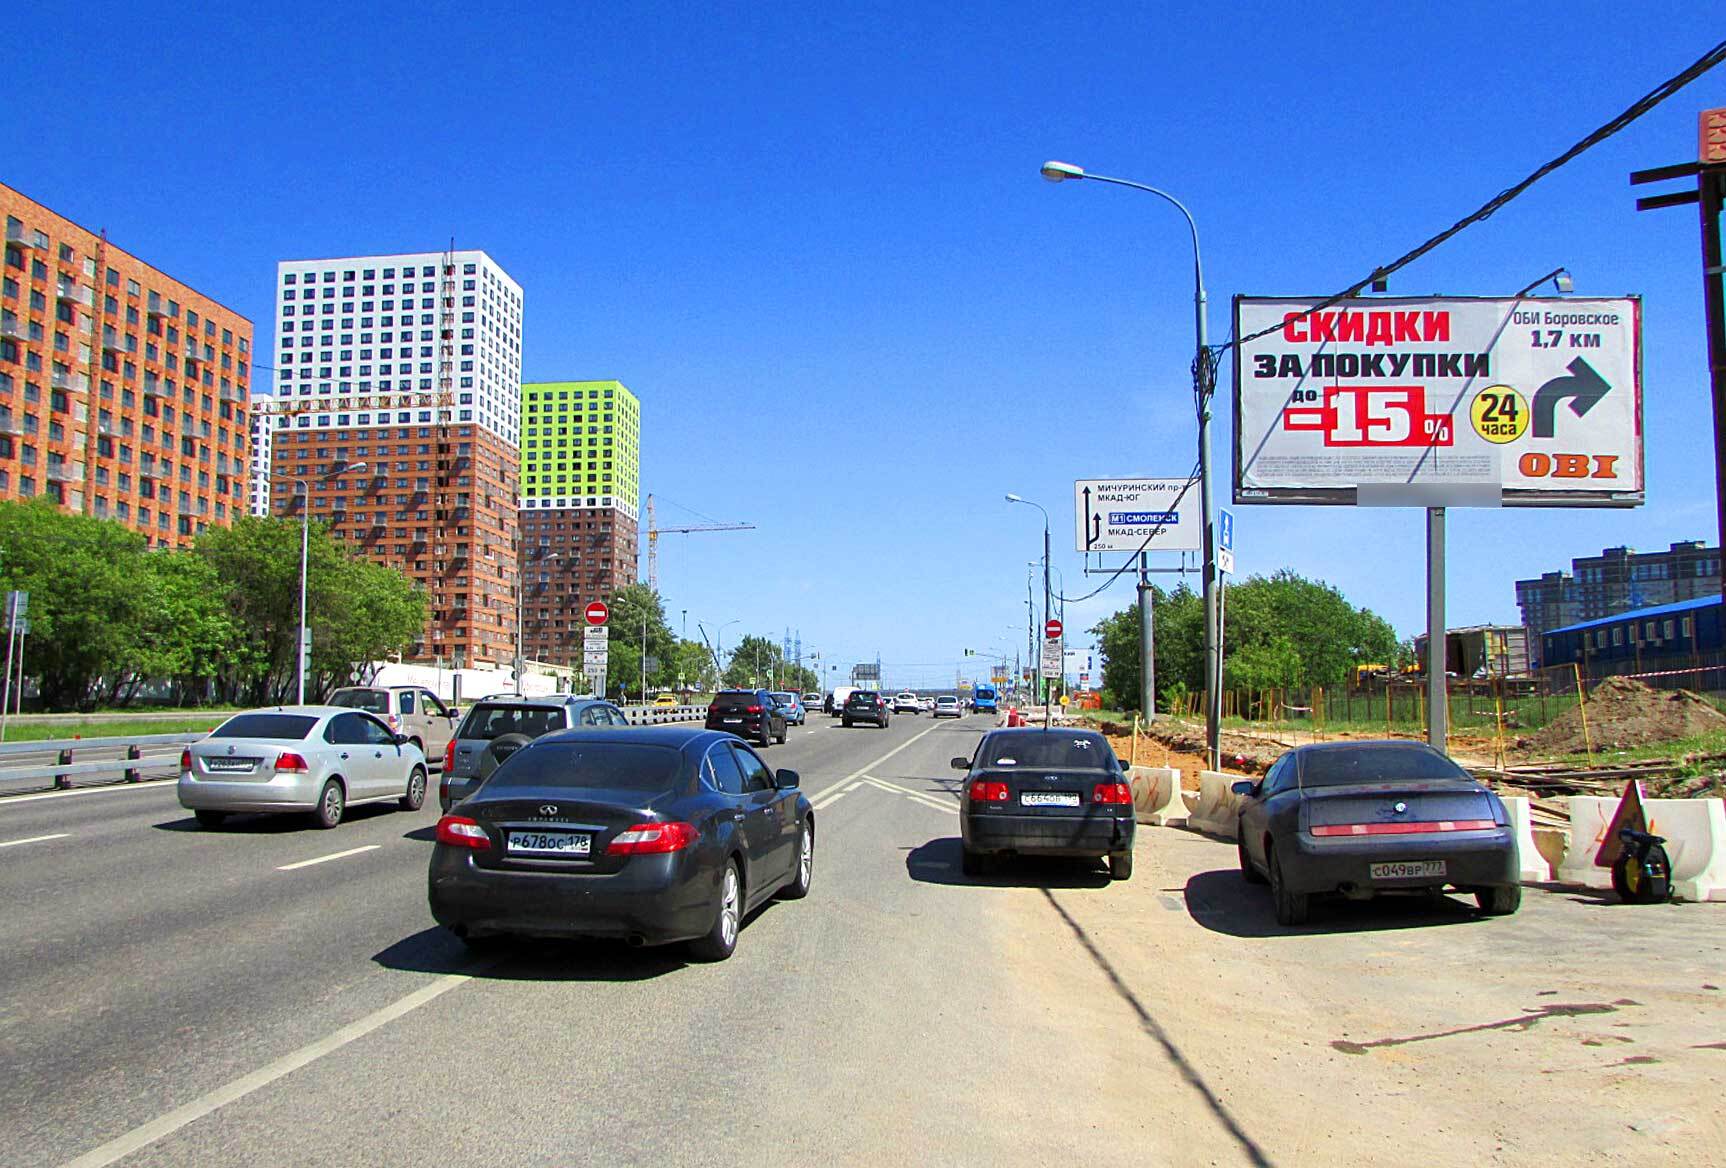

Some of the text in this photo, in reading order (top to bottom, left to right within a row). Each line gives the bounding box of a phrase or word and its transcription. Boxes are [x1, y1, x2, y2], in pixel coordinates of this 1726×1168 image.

[1513, 312, 1619, 327] ОБИ Боровское
[1284, 311, 1449, 346] СКИДКИ
[1531, 330, 1601, 348] 1,7 км
[1254, 353, 1489, 378] ЗА ПОКУПКИ
[1481, 393, 1518, 422] 24
[1481, 423, 1518, 435] часа
[1518, 452, 1619, 478] OBI
[1097, 482, 1166, 492] МИЧУРИНСКИЙ
[1097, 494, 1140, 502] МКАД-ЮГ
[1108, 528, 1167, 536] МКАД-СЕВЕР
[1374, 864, 1422, 877] С049ВР
